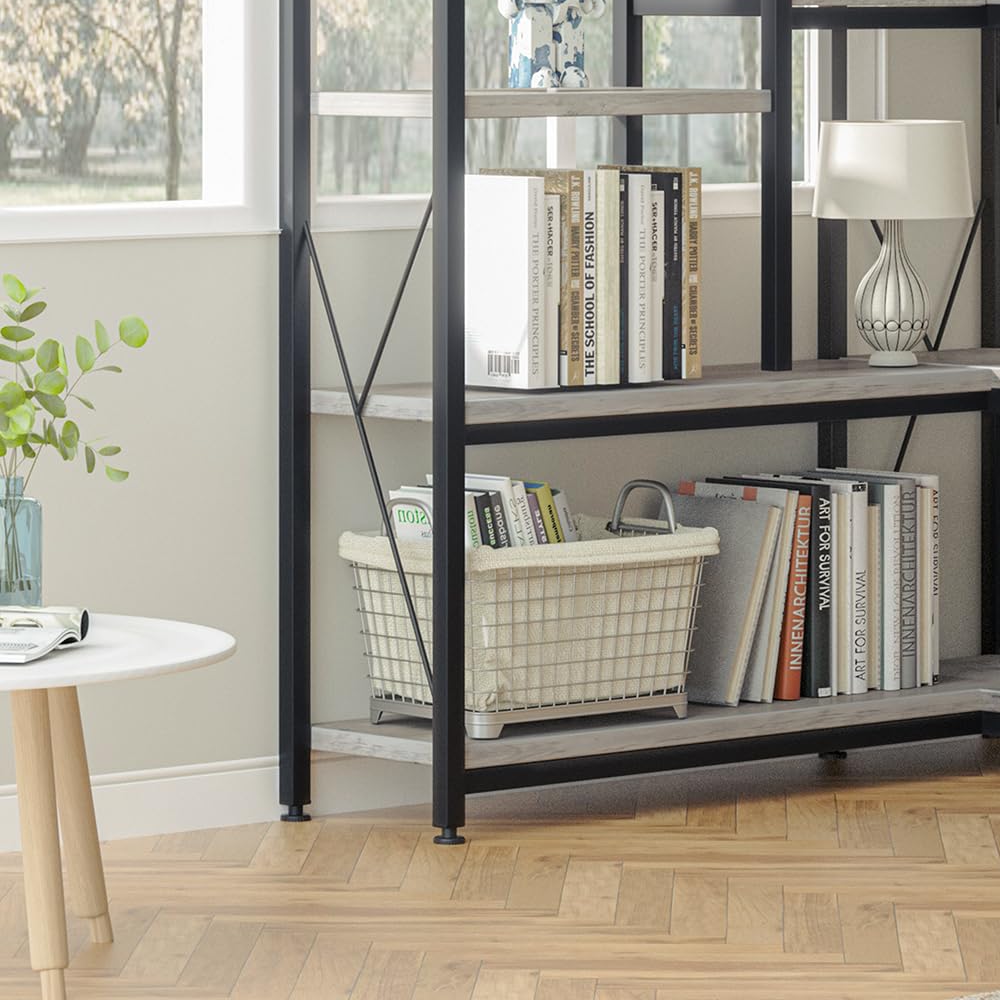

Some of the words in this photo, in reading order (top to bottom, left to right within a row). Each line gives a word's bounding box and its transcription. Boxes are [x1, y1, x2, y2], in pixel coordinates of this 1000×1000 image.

[571, 226, 580, 249] HARRY
[584, 211, 595, 269] FASHION
[688, 221, 698, 244] HARRY
[571, 251, 580, 278] POTTER
[688, 246, 698, 272] POTTER
[584, 273, 595, 291] OF
[584, 294, 595, 348] SCHOOL
[571, 331, 580, 362] SECRETS
[689, 326, 698, 356] SECRETS
[584, 351, 595, 378] THE
[819, 498, 830, 521] ART
[819, 525, 830, 551] FOR
[789, 505, 811, 670] INNENARCHITEKTUR
[819, 554, 830, 611] SURVIVAL
[901, 491, 916, 658] INNENARCHITEKTUR
[855, 570, 866, 625] SURVIVAL
[855, 628, 866, 654] FOR
[855, 658, 866, 681] ART
